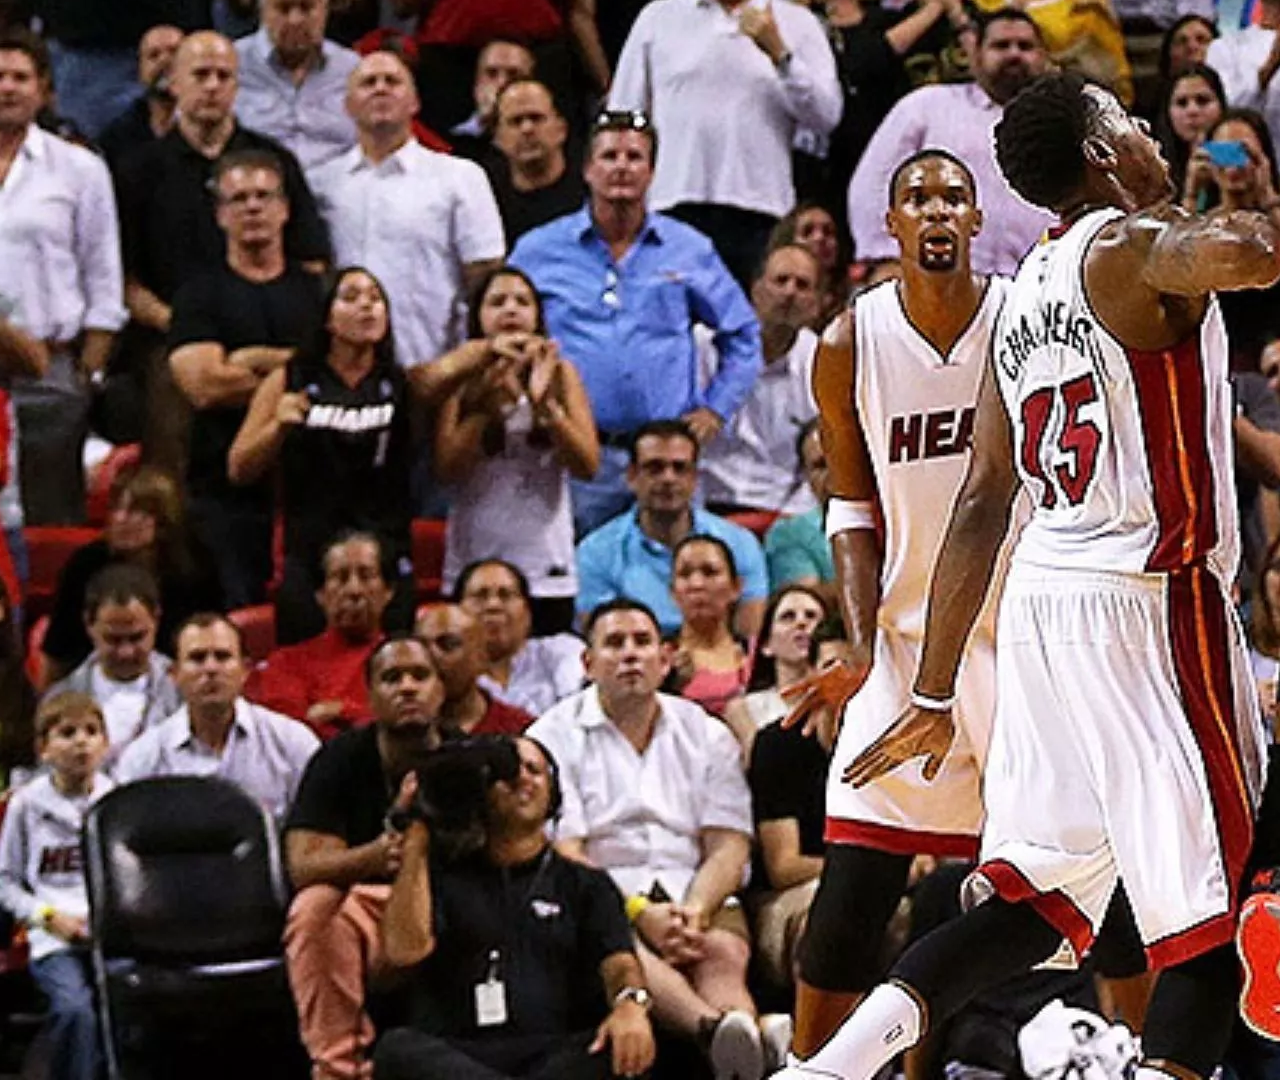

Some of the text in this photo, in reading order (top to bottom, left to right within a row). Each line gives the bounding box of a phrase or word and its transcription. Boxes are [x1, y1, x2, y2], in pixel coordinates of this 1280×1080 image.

[306, 403, 395, 432] MIAMI
[889, 407, 976, 464] HEA
[38, 844, 83, 875] HE
